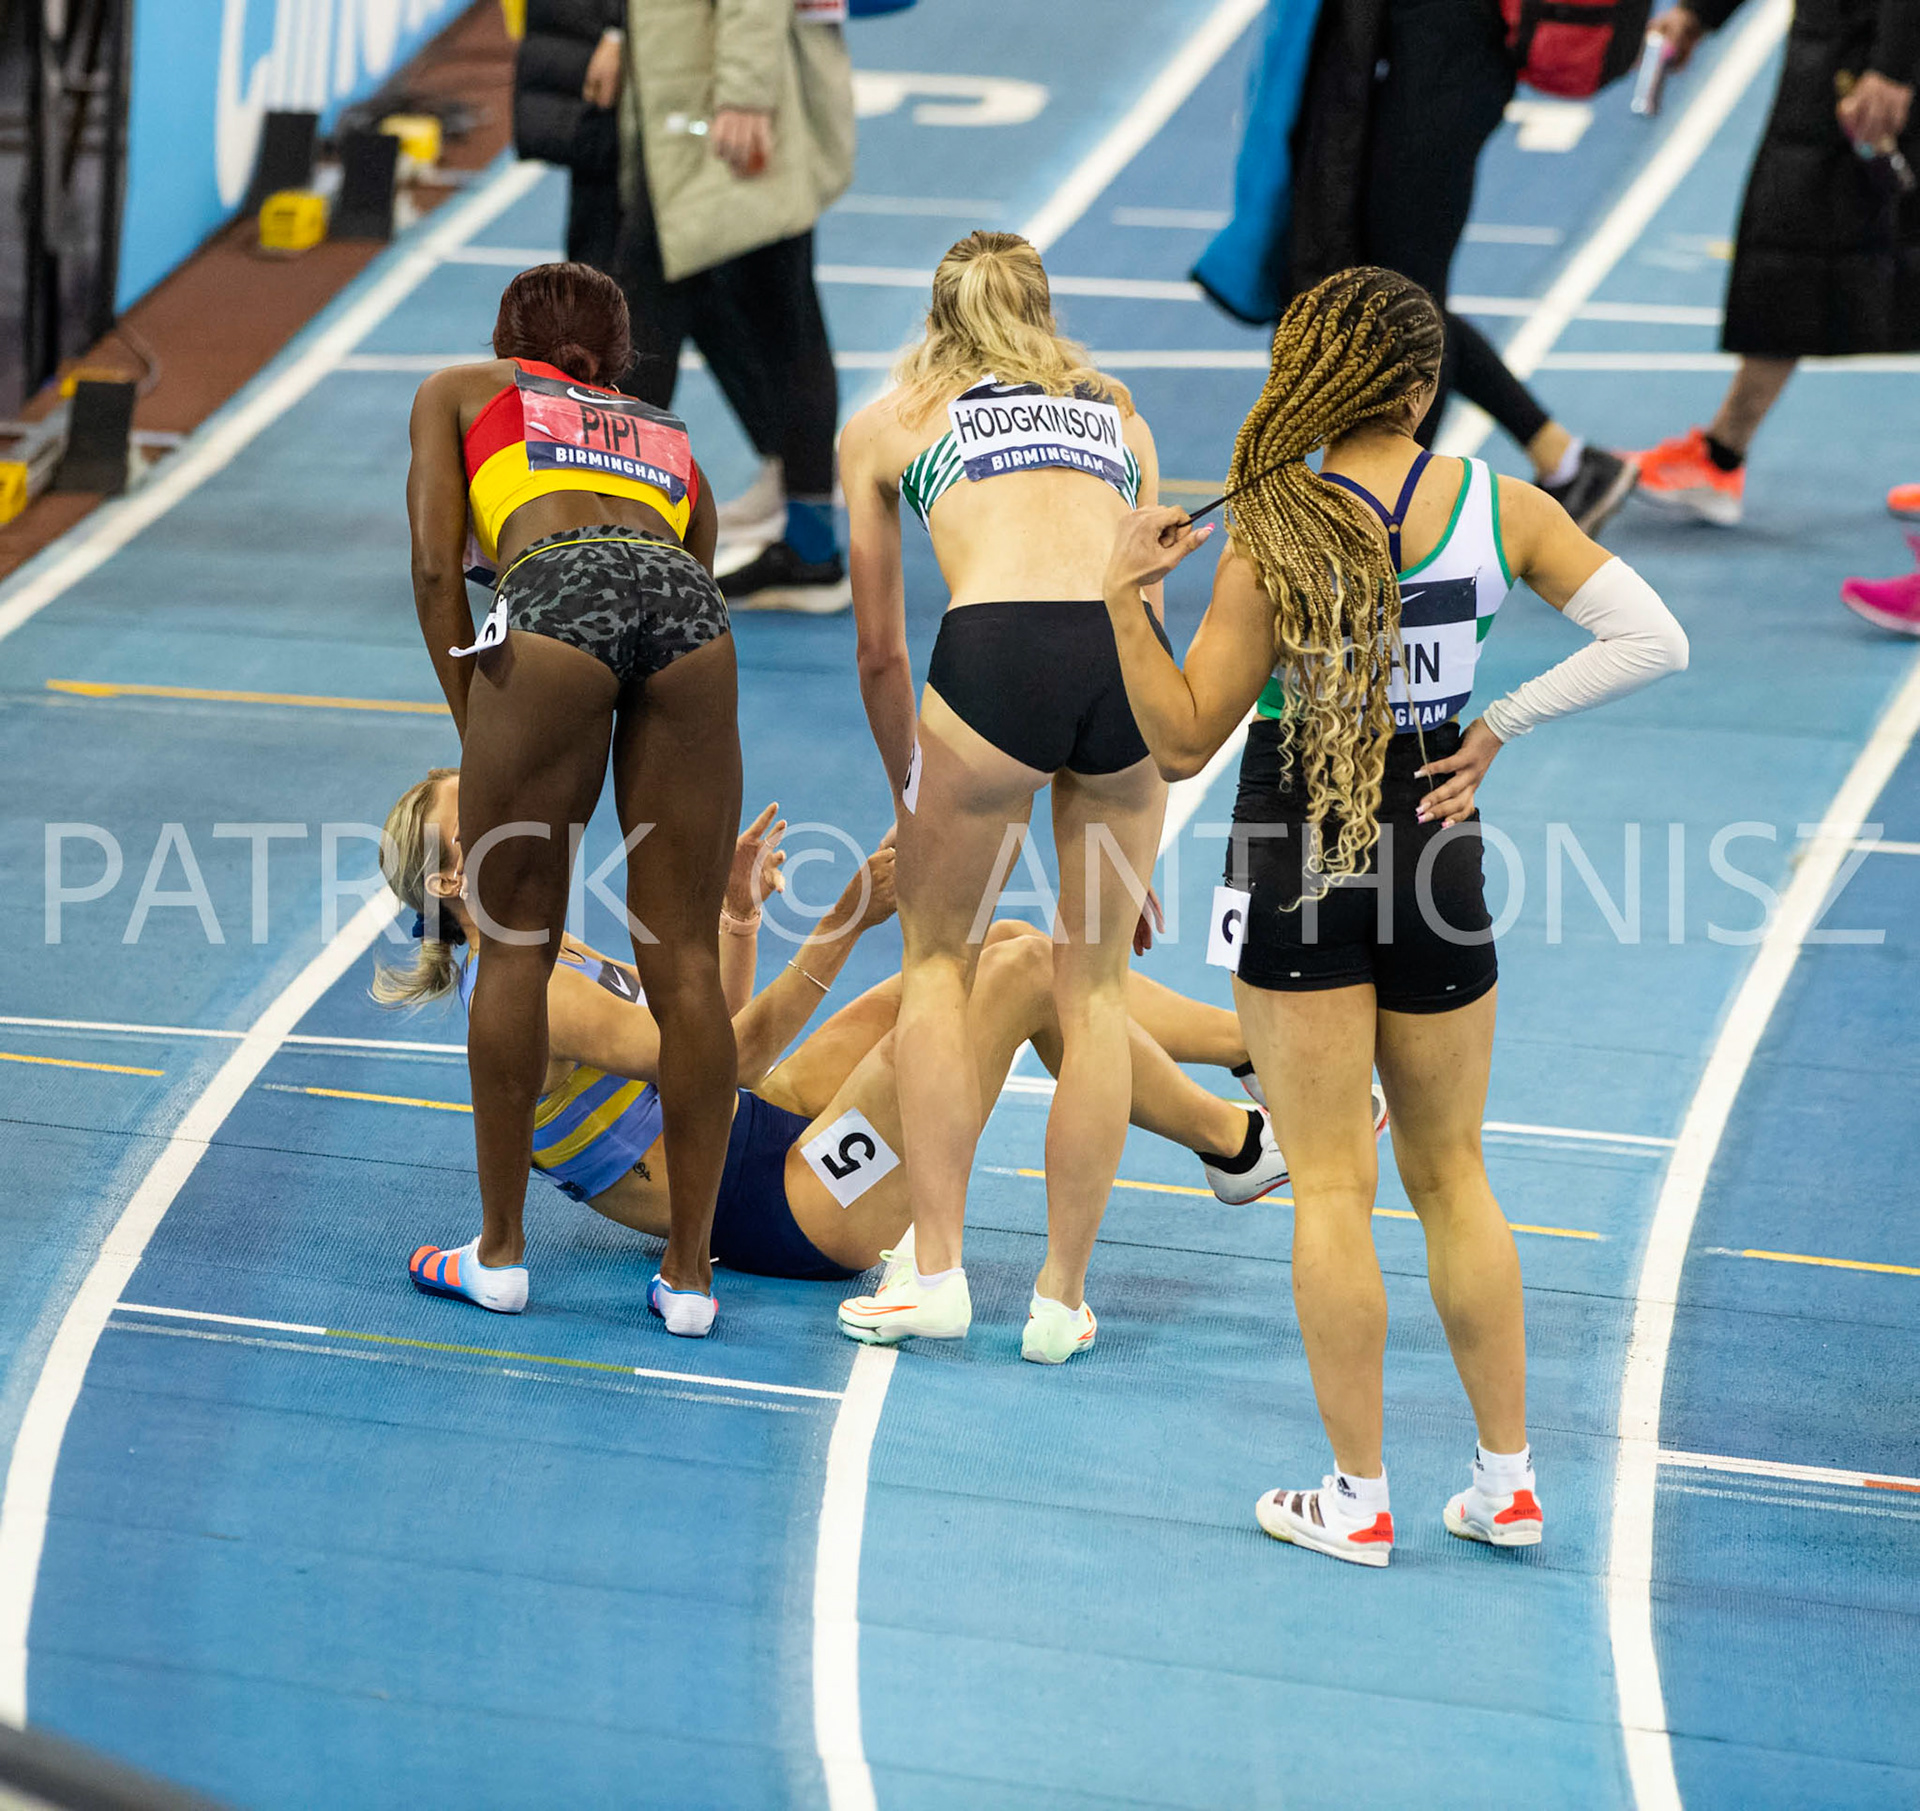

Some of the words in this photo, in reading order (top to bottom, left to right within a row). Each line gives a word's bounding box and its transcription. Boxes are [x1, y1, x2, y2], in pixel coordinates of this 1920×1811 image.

[579, 404, 641, 458] PIPI
[955, 404, 1117, 448] HODGKINSON
[555, 447, 671, 489] BIRMINGHAM
[991, 447, 1104, 473] BIRMINGHAM
[821, 1132, 876, 1180] 5
